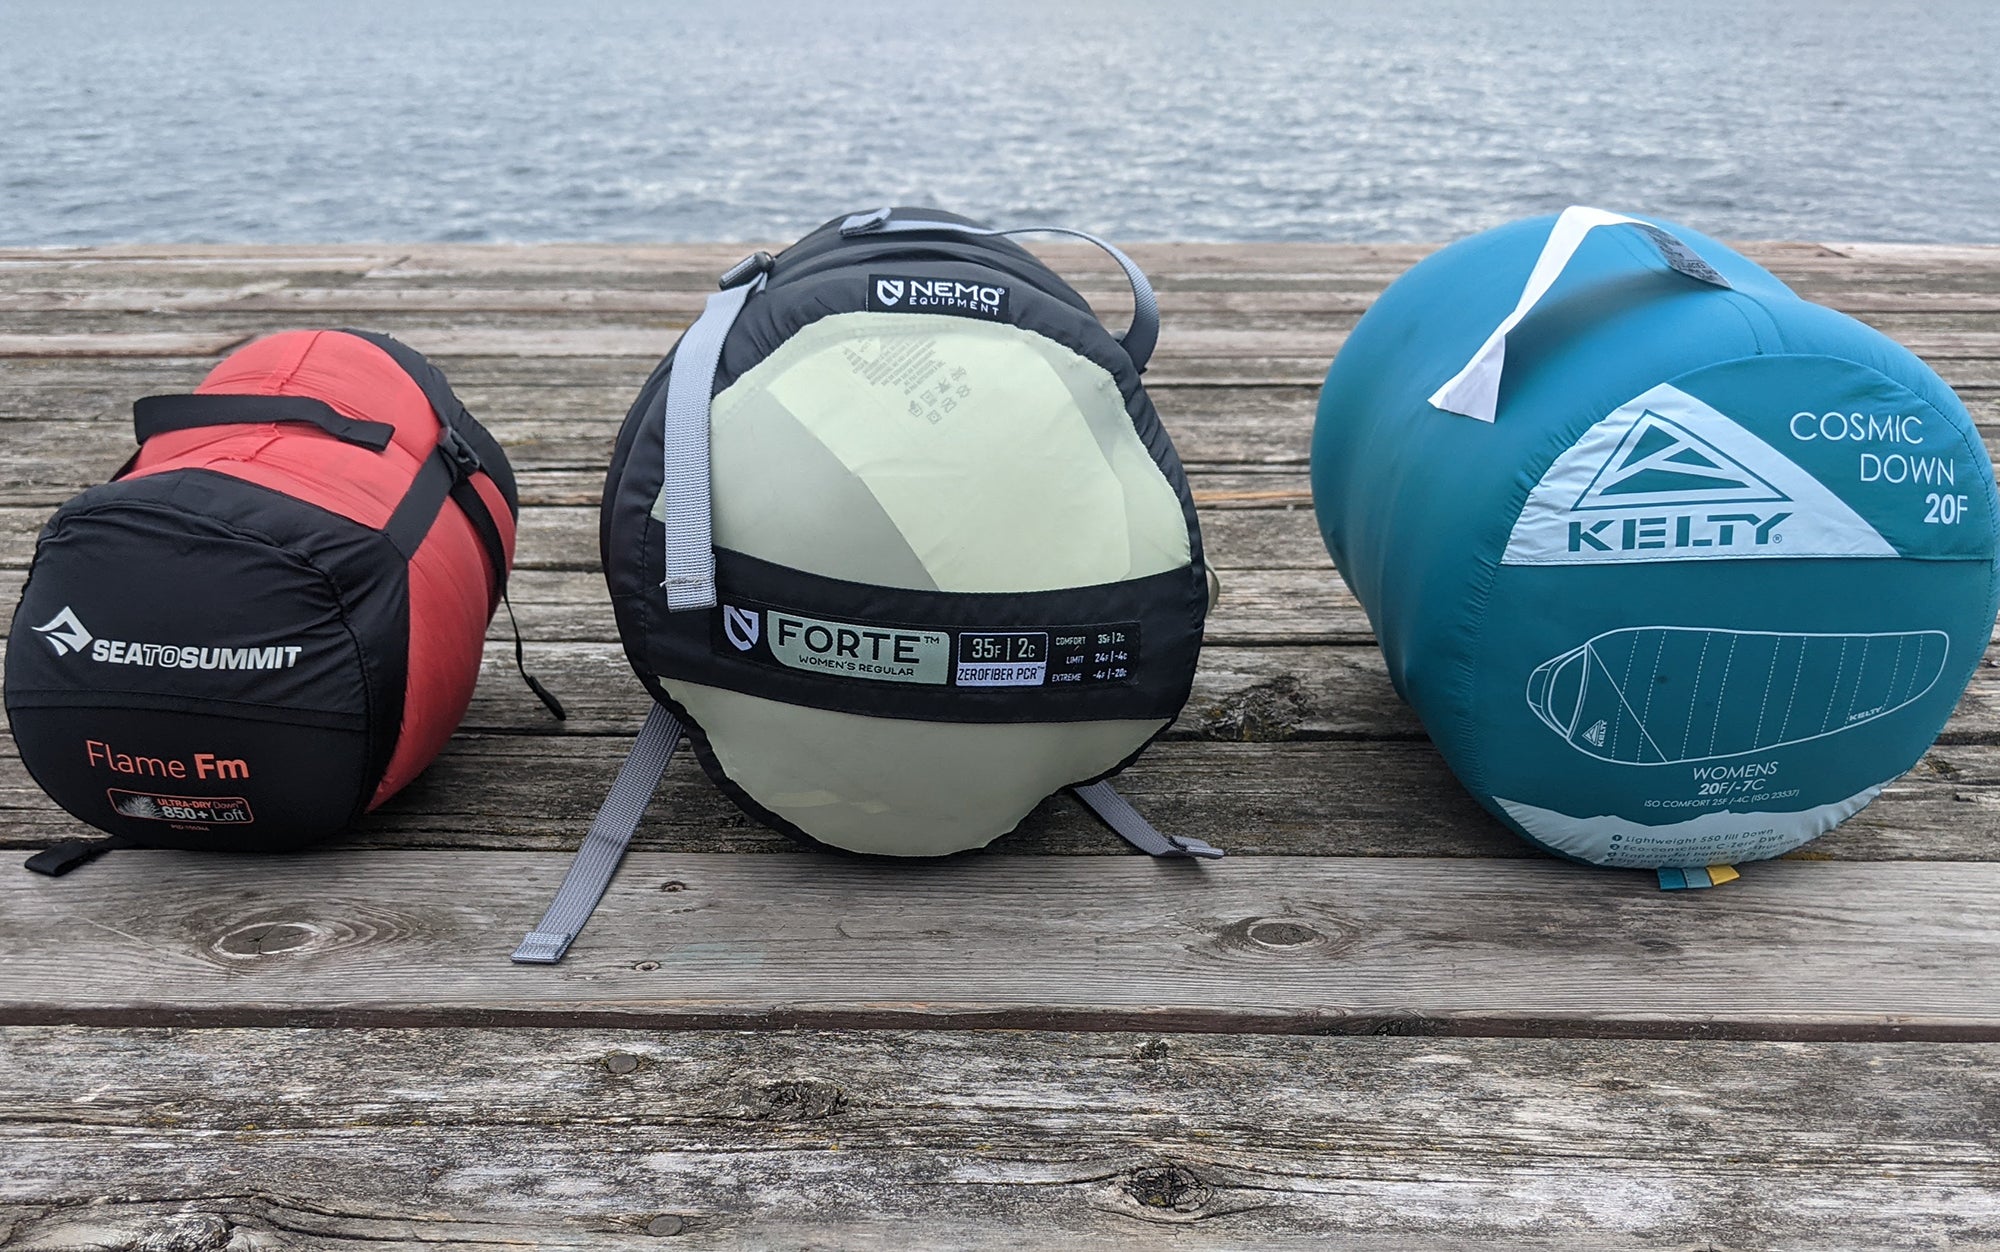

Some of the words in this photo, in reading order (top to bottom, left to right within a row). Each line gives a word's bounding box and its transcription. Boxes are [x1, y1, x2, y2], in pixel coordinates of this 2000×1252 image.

[909, 297, 999, 316] EQUIPMENT
[1790, 411, 1924, 445] COSMIC
[1860, 453, 1955, 486] DOWN
[1924, 492, 1968, 525] 20F
[1055, 636, 1086, 646] COMFORT
[798, 654, 856, 671] WOMEN'S
[858, 663, 914, 676] REGULAR
[1065, 655, 1084, 665] LIMIT
[957, 667, 1014, 682] ZEROFIBER
[1051, 672, 1082, 682] EXTREME
[1849, 705, 1883, 721] KELTY
[1597, 719, 1607, 747] KELTY
[85, 739, 187, 779] Flame
[193, 753, 250, 780] Fm
[1693, 761, 1779, 781] WOMENS
[1698, 778, 1767, 796] 20F/-7C
[157, 798, 212, 809] ULTRA-DRY
[1644, 799, 1660, 808] ISO
[1662, 798, 1711, 809] COMFORT
[162, 806, 209, 820] 850+
[211, 808, 247, 822] Loft
[1625, 836, 1697, 846] Lightweight
[1701, 834, 1722, 843] 550
[1725, 832, 1740, 841] fill
[1742, 828, 1774, 839] Down
[1758, 833, 1785, 843] DWR
